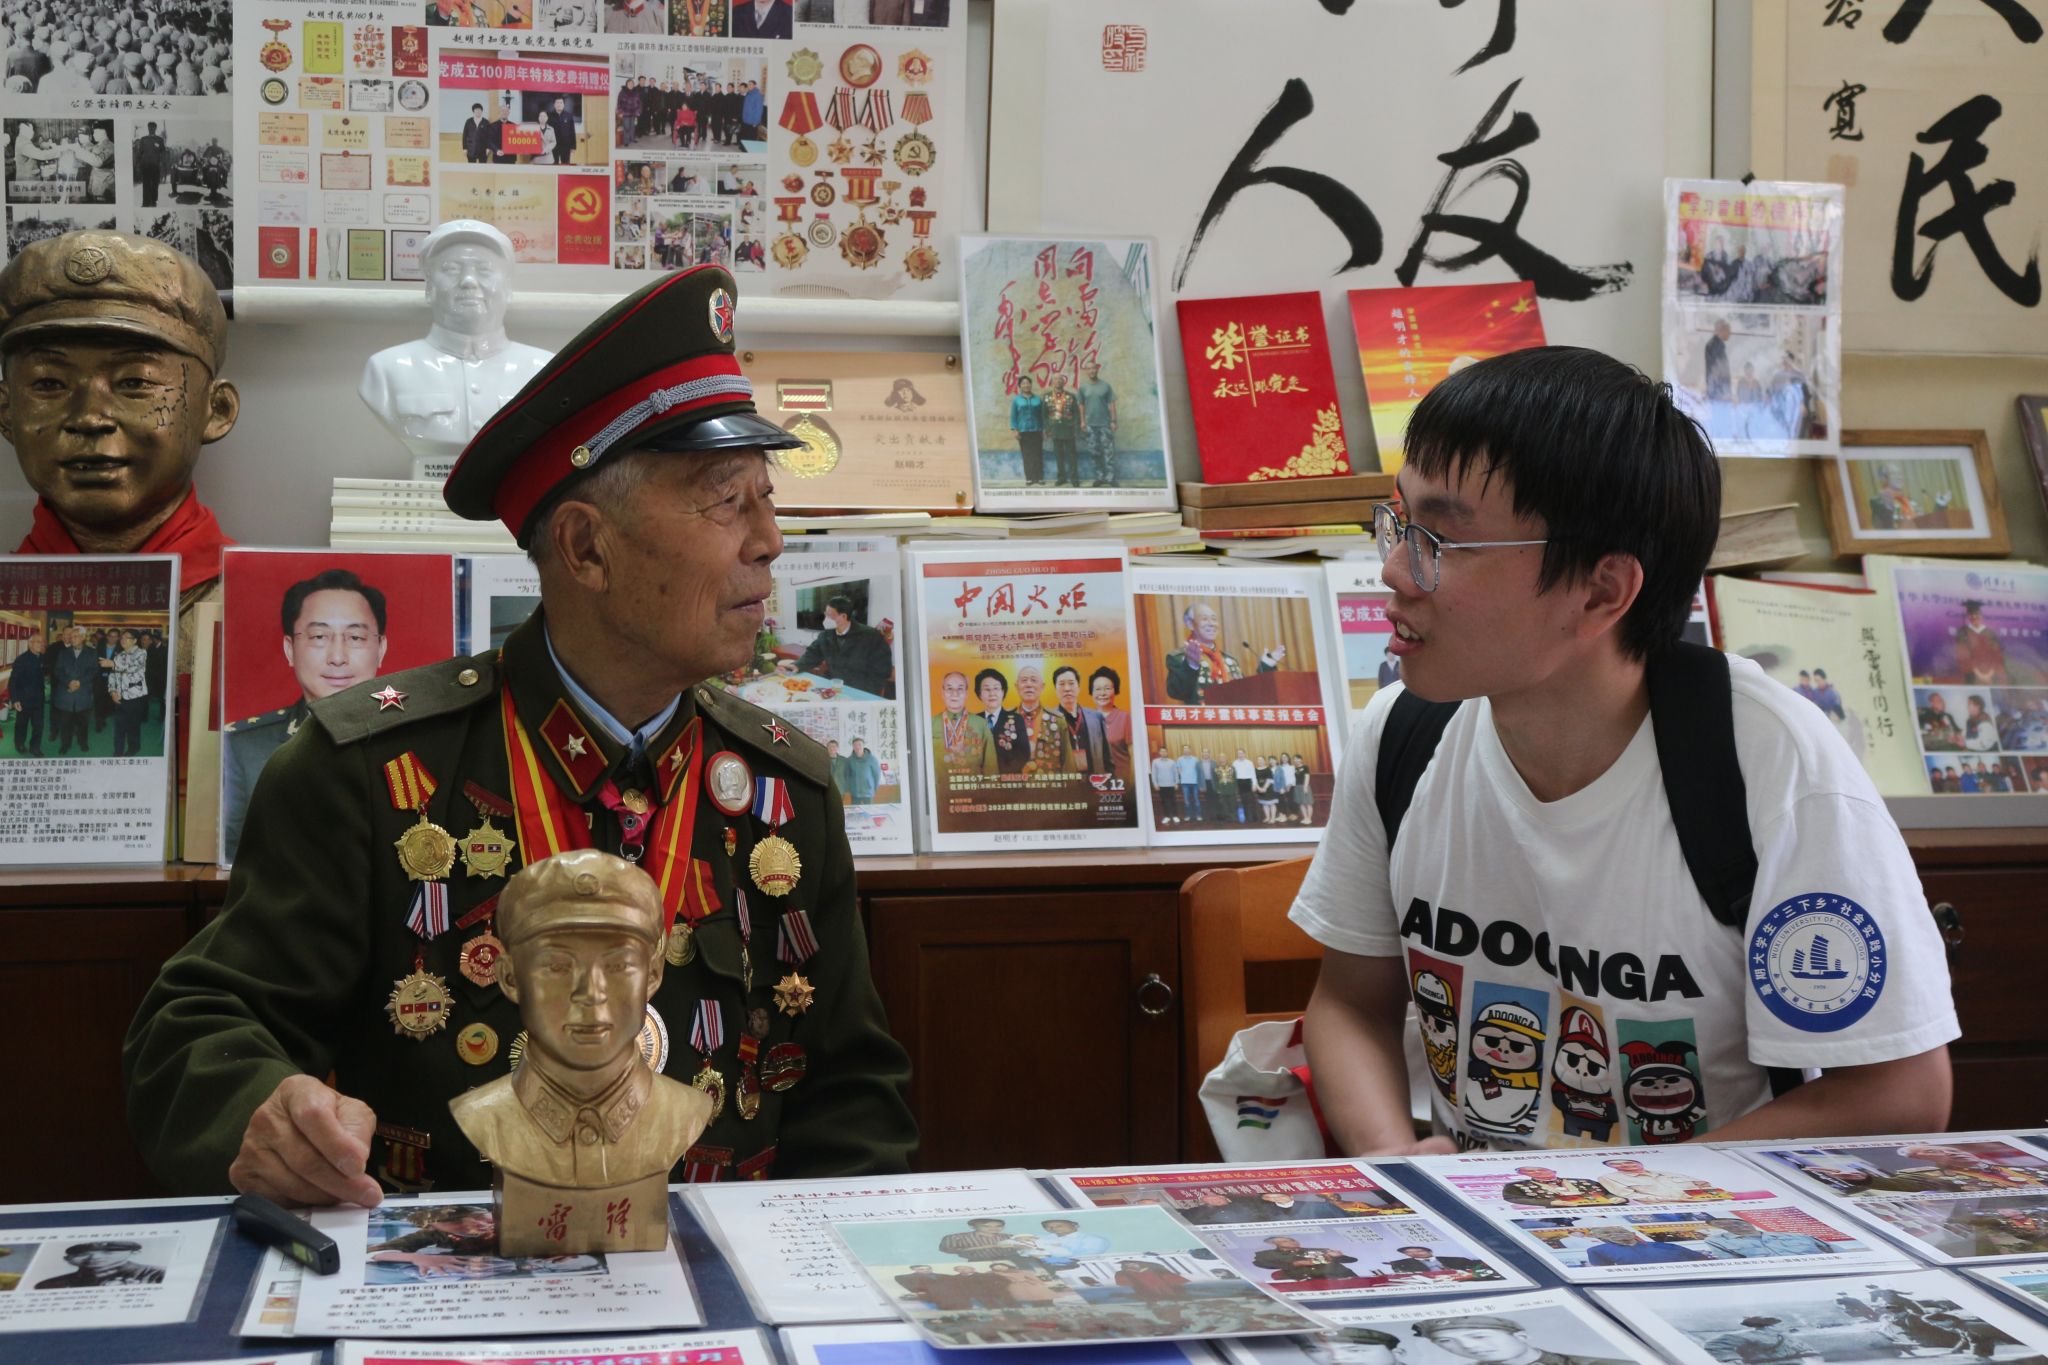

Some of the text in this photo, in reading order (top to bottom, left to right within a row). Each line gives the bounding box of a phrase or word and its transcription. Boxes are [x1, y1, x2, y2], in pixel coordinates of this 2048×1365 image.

[1395, 0, 1634, 302] 友
[954, 580, 1088, 618] 中国火炬
[1099, 794, 1123, 803] 2022
[1110, 779, 1125, 790] 12
[1771, 939, 1783, 959] WUXI
[1781, 916, 1822, 939] UNIVERSITY
[1836, 919, 1867, 961] TECHNOLOGY
[1488, 1009, 1535, 1028] ADOONGA
[1581, 1019, 1592, 1033] A
[537, 1199, 631, 1241] 雷锋
